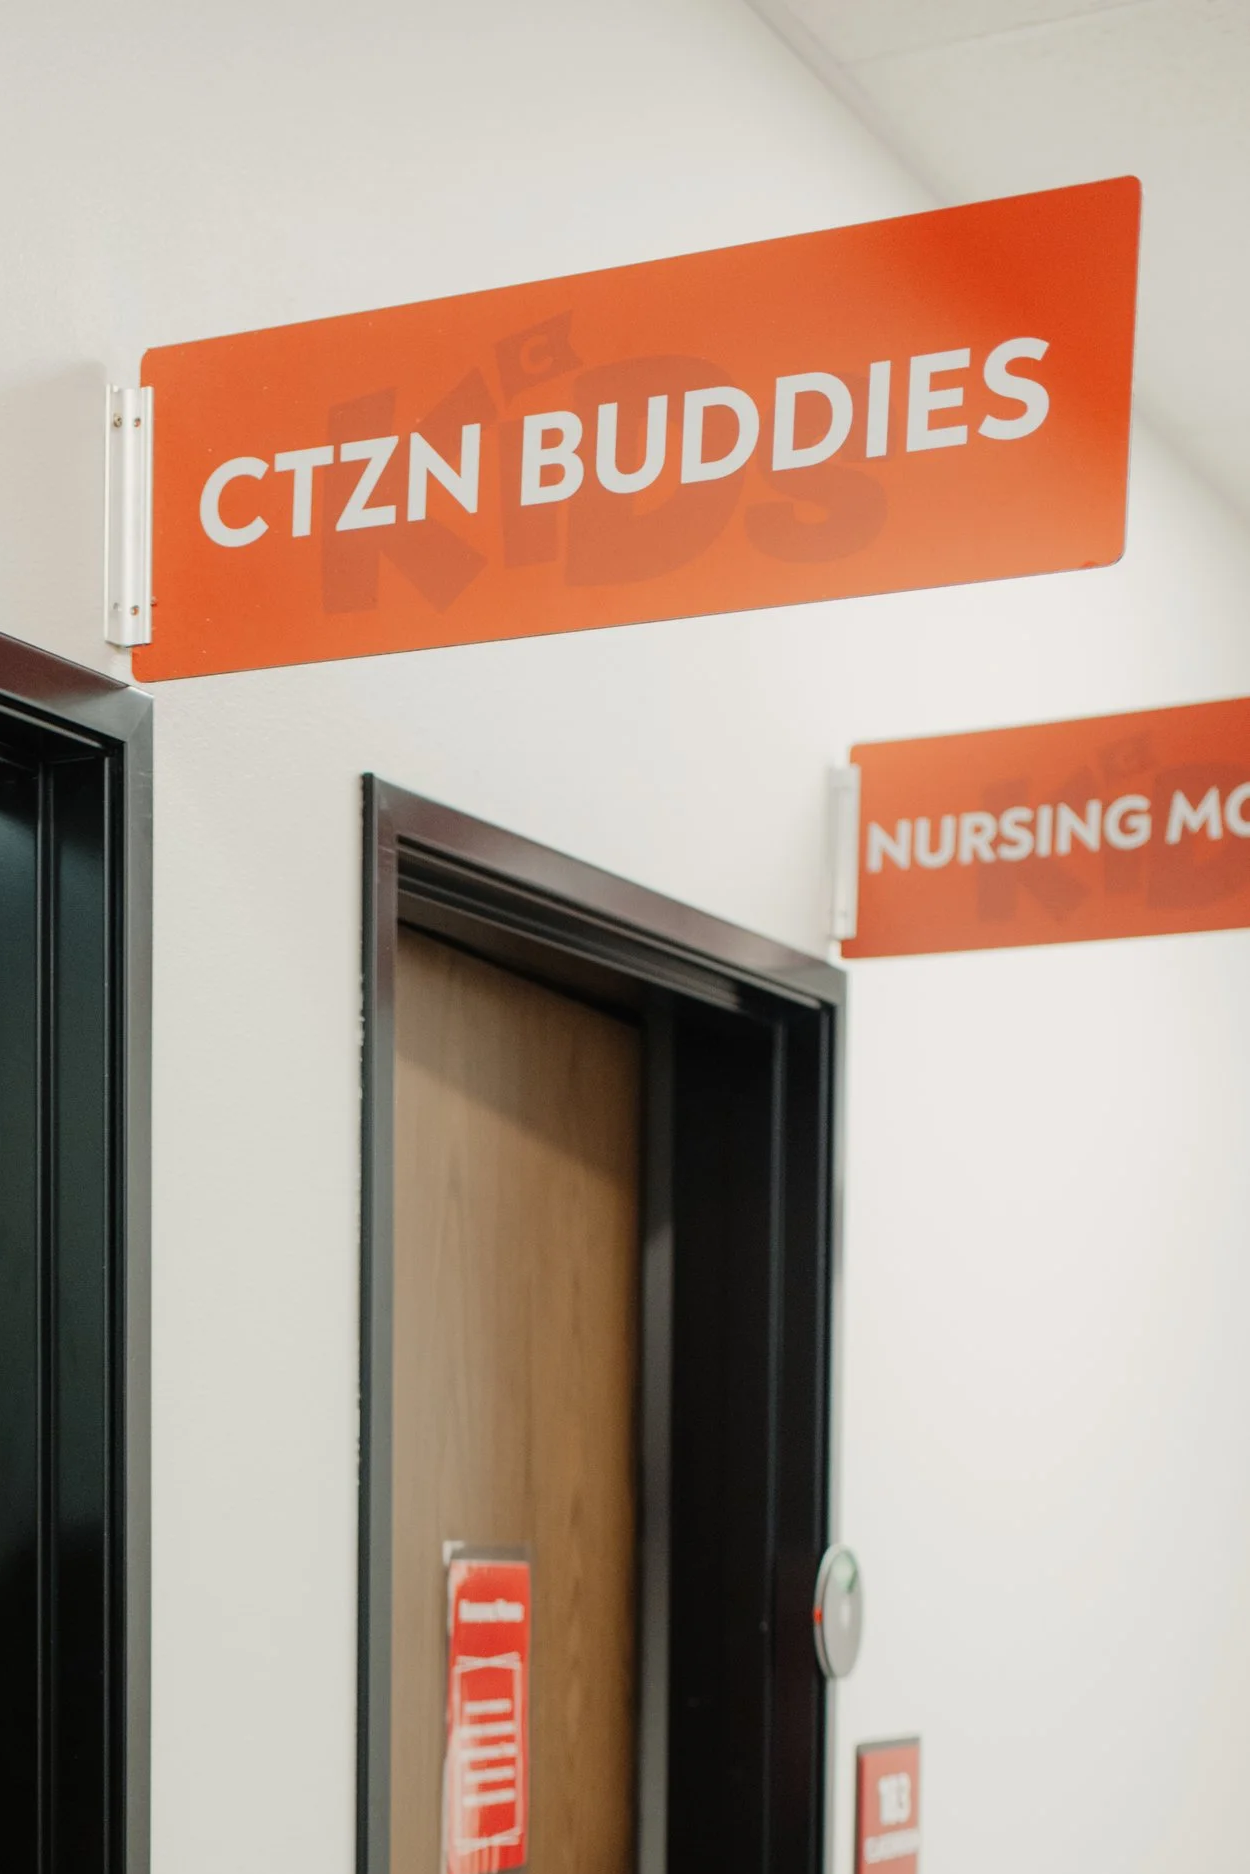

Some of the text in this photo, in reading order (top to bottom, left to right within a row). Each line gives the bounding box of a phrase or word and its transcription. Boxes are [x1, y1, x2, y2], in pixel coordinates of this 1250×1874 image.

[200, 337, 1050, 547] CTZN BUDDIES
[867, 795, 1151, 873] NURSING
